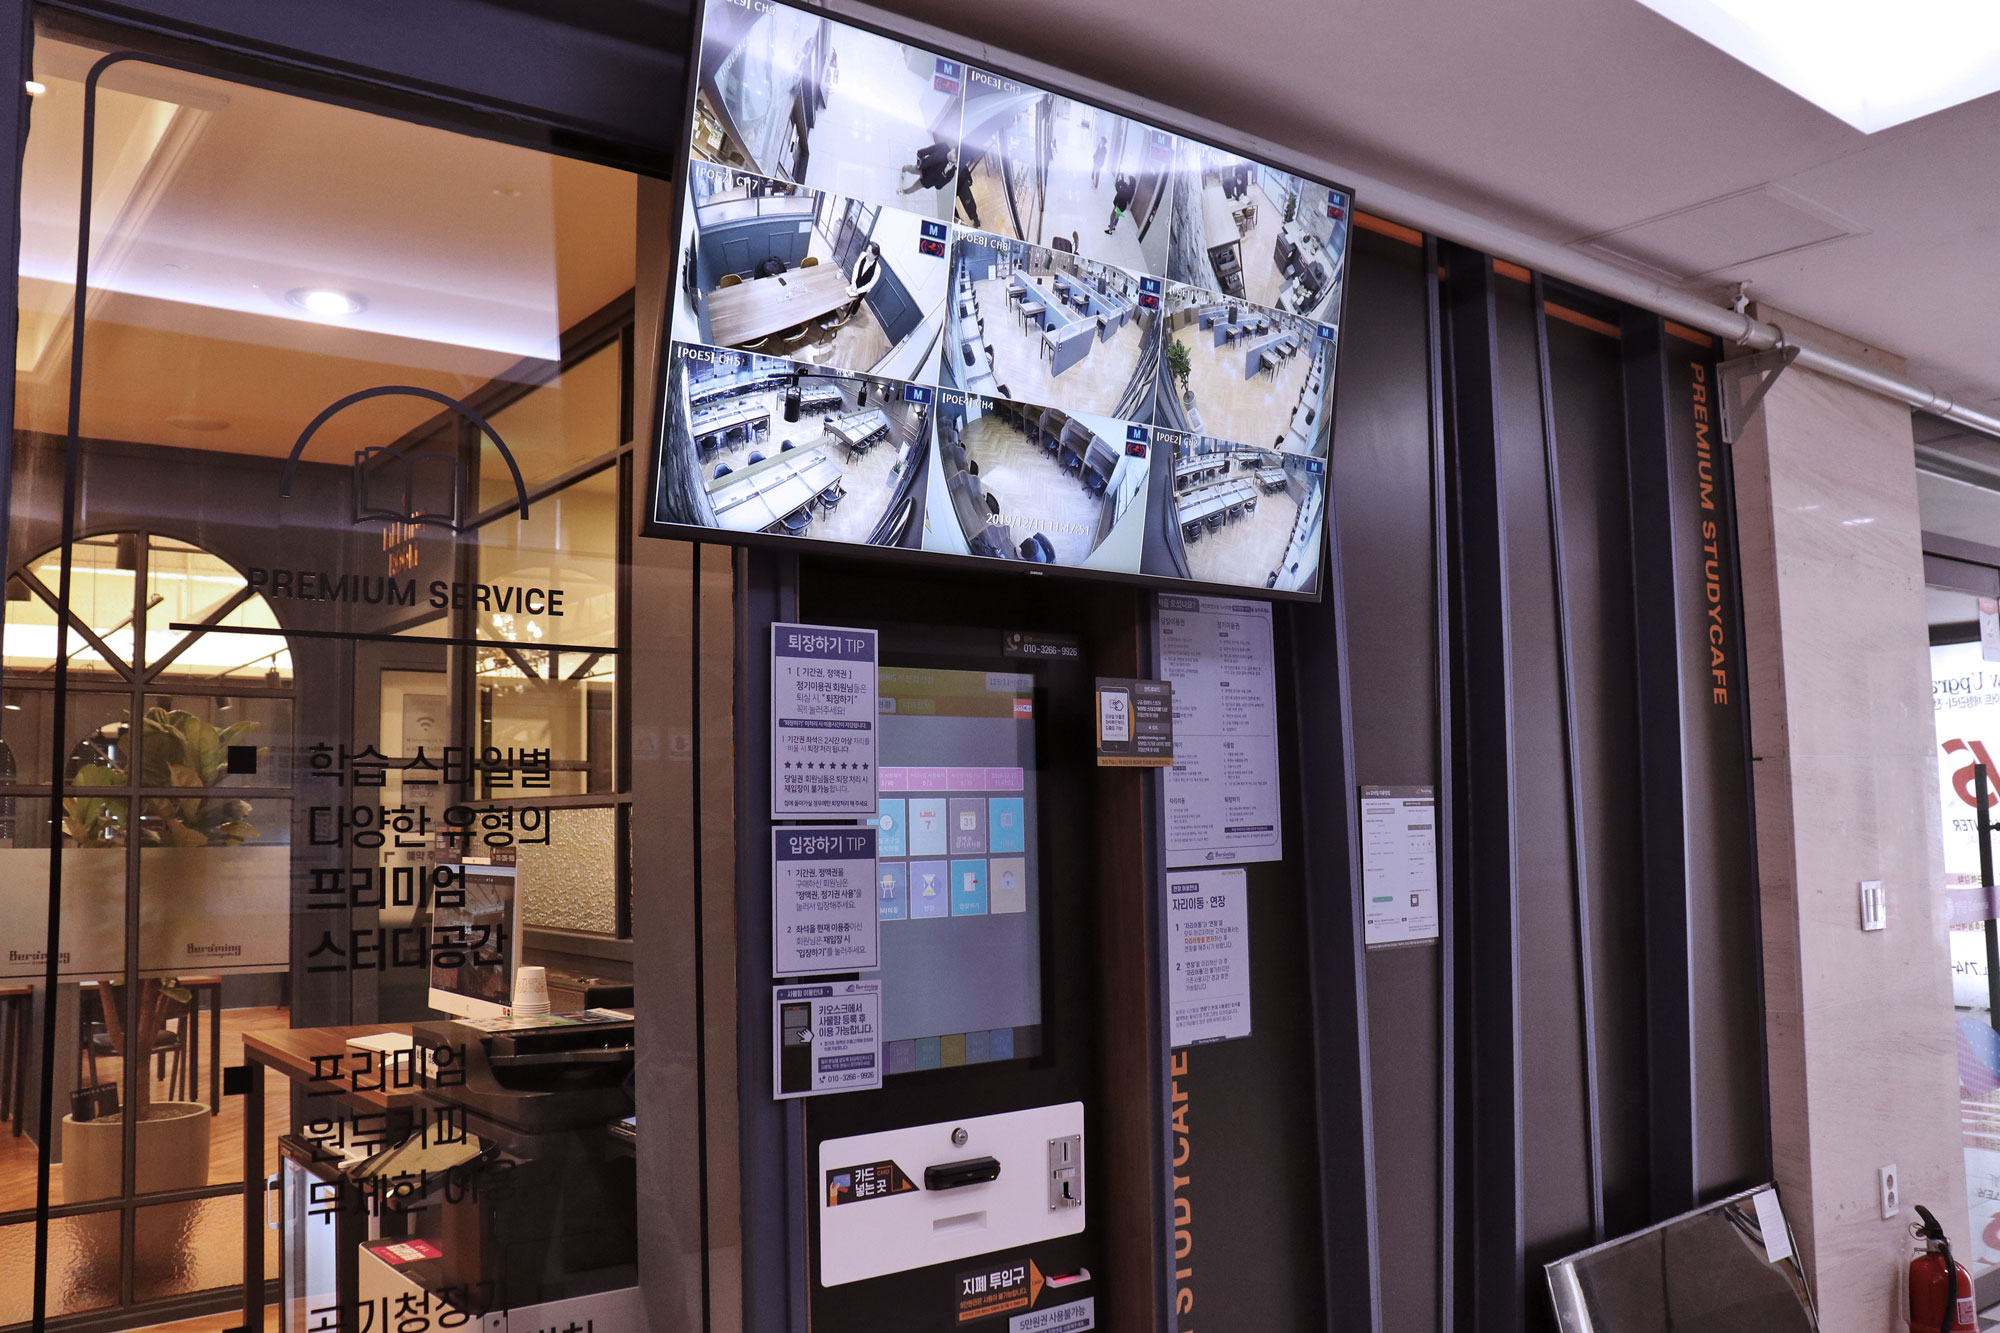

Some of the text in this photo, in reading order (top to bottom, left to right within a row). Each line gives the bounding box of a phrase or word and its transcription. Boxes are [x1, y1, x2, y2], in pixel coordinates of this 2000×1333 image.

[1690, 362, 1728, 706] PREMIUM STUDYCAFE
[249, 566, 564, 617] PREMIUM SERVICE
[788, 633, 865, 654] 퇴장하기 TIP
[787, 667, 791, 675] 1
[826, 668, 847, 679] 정액권
[796, 681, 867, 694] 정기이용권 회원님들은
[787, 735, 805, 744] 기간권
[824, 737, 840, 745] 2시간
[309, 742, 551, 788] 학습 스타일별
[309, 804, 431, 849] 다양한
[442, 804, 551, 848] 유형의
[963, 817, 973, 827] 31
[789, 836, 843, 855] 입장하기
[846, 837, 866, 852] TIP
[787, 869, 791, 877] 1
[306, 865, 467, 910] 프리미엄
[1172, 895, 1226, 911] 자리이동 연장
[787, 926, 792, 934] 2
[1175, 923, 1179, 931] 1
[823, 935, 843, 945] 재입장
[306, 922, 509, 975] 스터디공간
[1176, 962, 1181, 971] 2
[818, 1003, 863, 1016] 키오스크에서
[818, 1015, 841, 1027] 사물함
[818, 1027, 834, 1037] 이용
[307, 1043, 467, 1097] 프리미엄
[307, 1106, 468, 1164] 원두커피
[855, 1167, 874, 1183] 카드
[855, 1179, 887, 1198] 넣는 곳
[308, 1169, 432, 1225] 무제한
[963, 1266, 1025, 1296] 지폐 투입구
[1020, 1314, 1048, 1331] 5만원권
